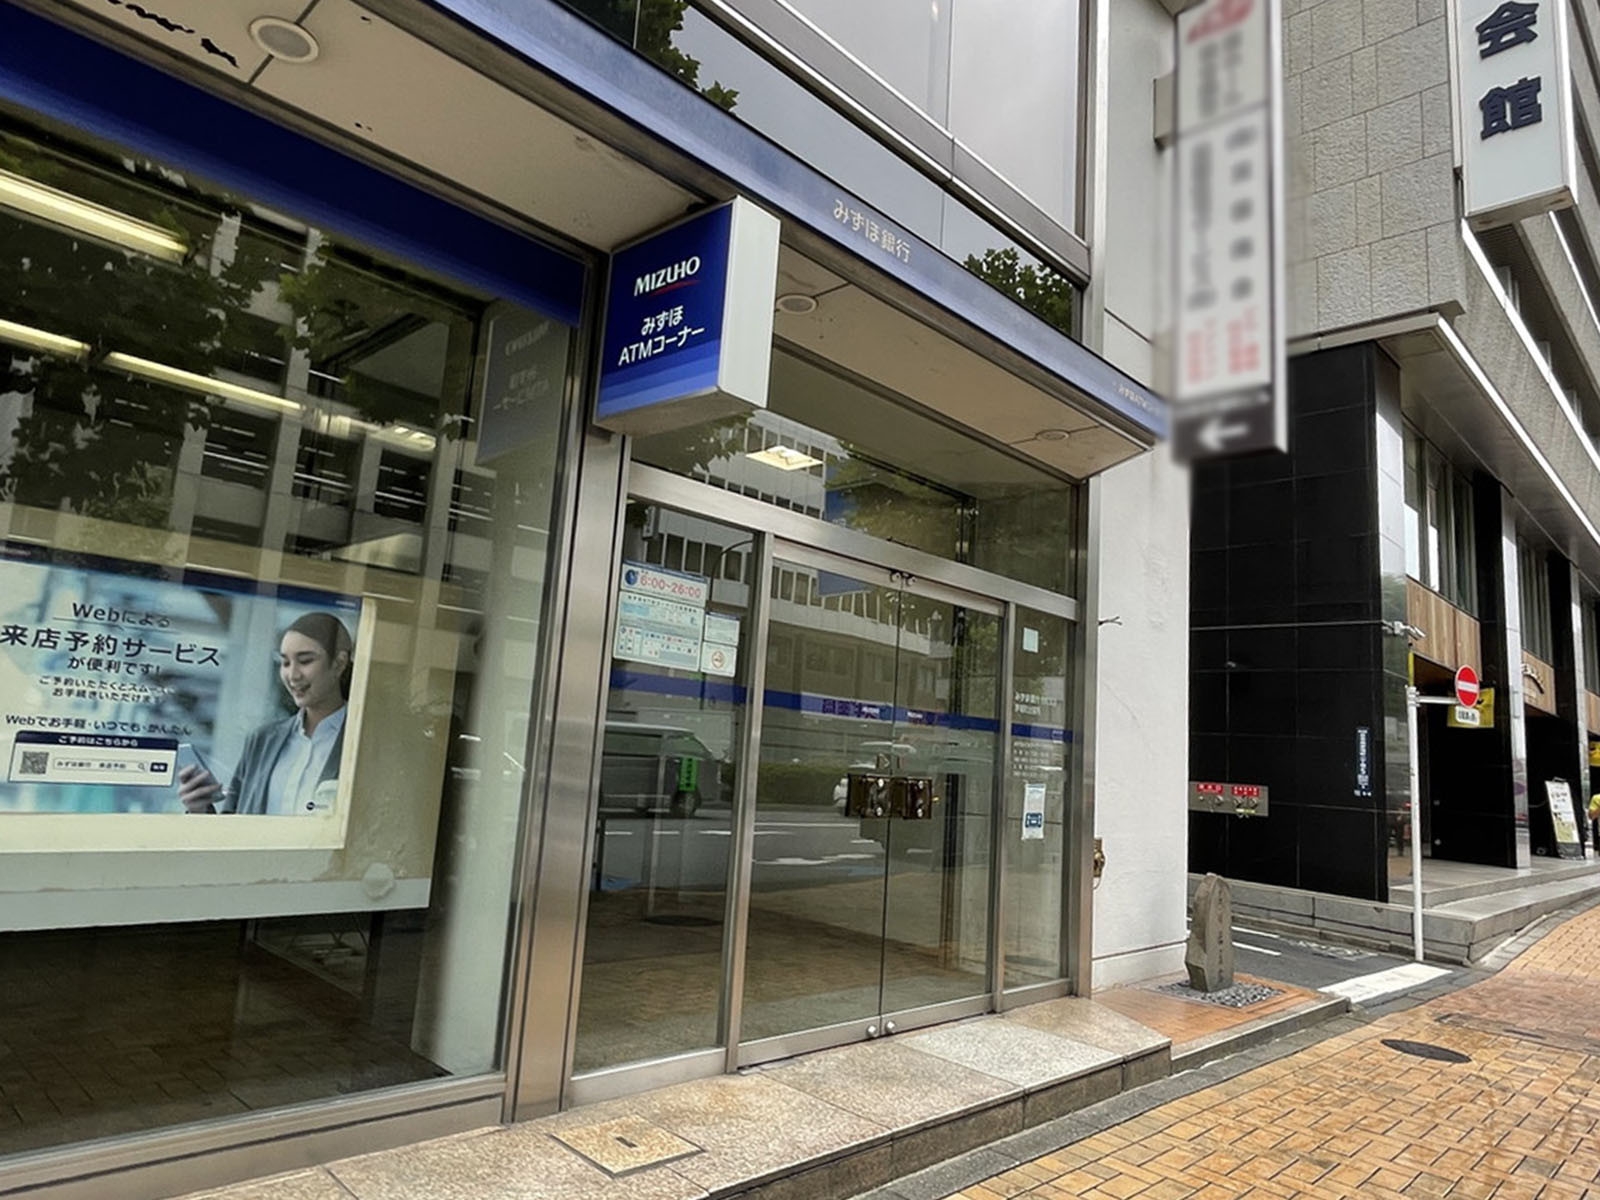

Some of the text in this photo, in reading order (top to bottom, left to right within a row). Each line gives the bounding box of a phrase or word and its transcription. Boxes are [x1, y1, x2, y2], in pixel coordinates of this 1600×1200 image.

[1475, 1, 1542, 141] 会館
[833, 198, 911, 264] みずほ銀行
[633, 256, 700, 297] MIZUHO
[641, 305, 684, 336] みずほ
[618, 327, 705, 367] ATMコーナー
[72, 602, 171, 628] Webによる
[0, 624, 221, 667] 来店予約サービス
